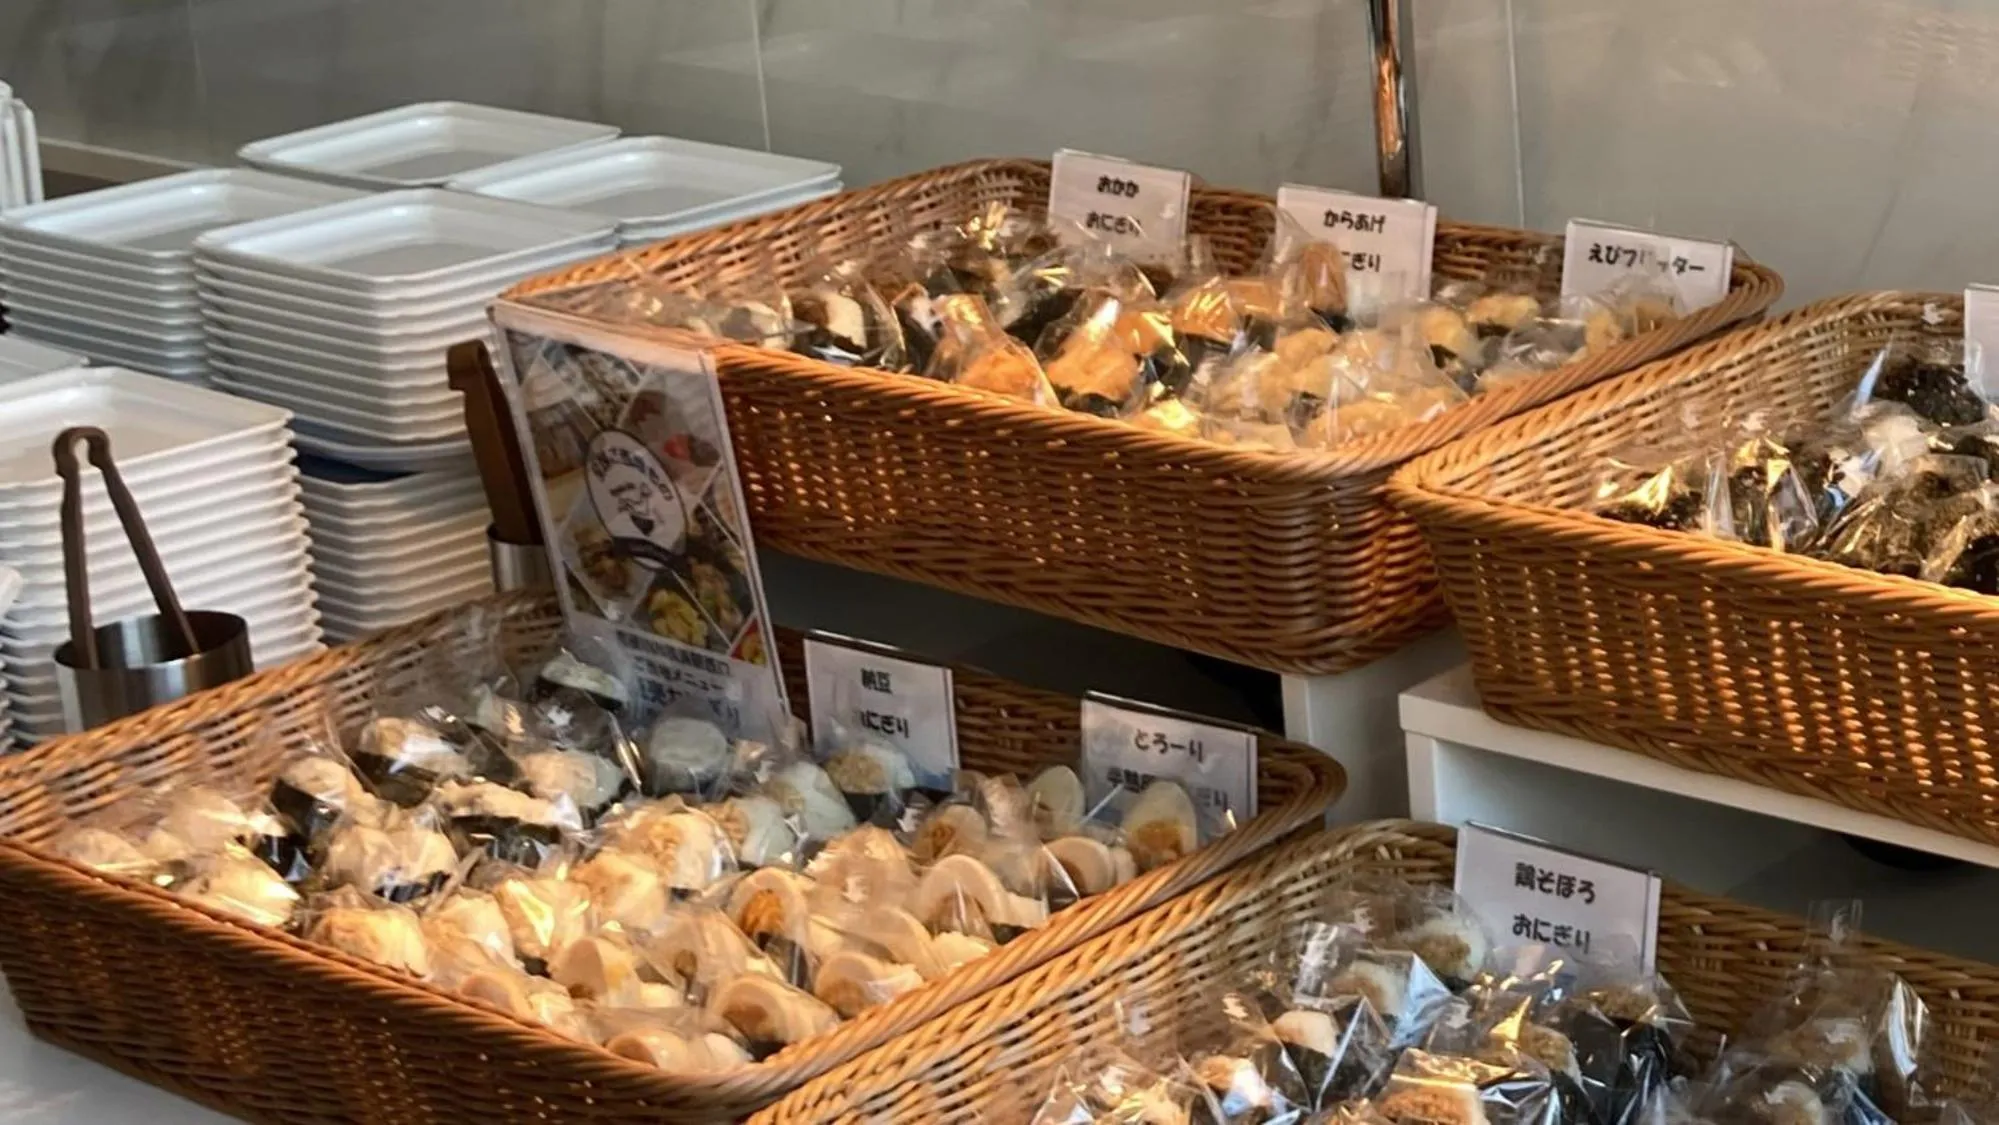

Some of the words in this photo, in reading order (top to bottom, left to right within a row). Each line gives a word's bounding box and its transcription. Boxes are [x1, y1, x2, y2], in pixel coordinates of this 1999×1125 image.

[1097, 174, 1139, 198] おかか
[1324, 209, 1386, 234] からあげ
[860, 709, 910, 738] にぎり
[1134, 728, 1203, 764] とろーり
[1514, 861, 1596, 904] 鶏そぼろ
[1512, 913, 1591, 954] おにぎり
